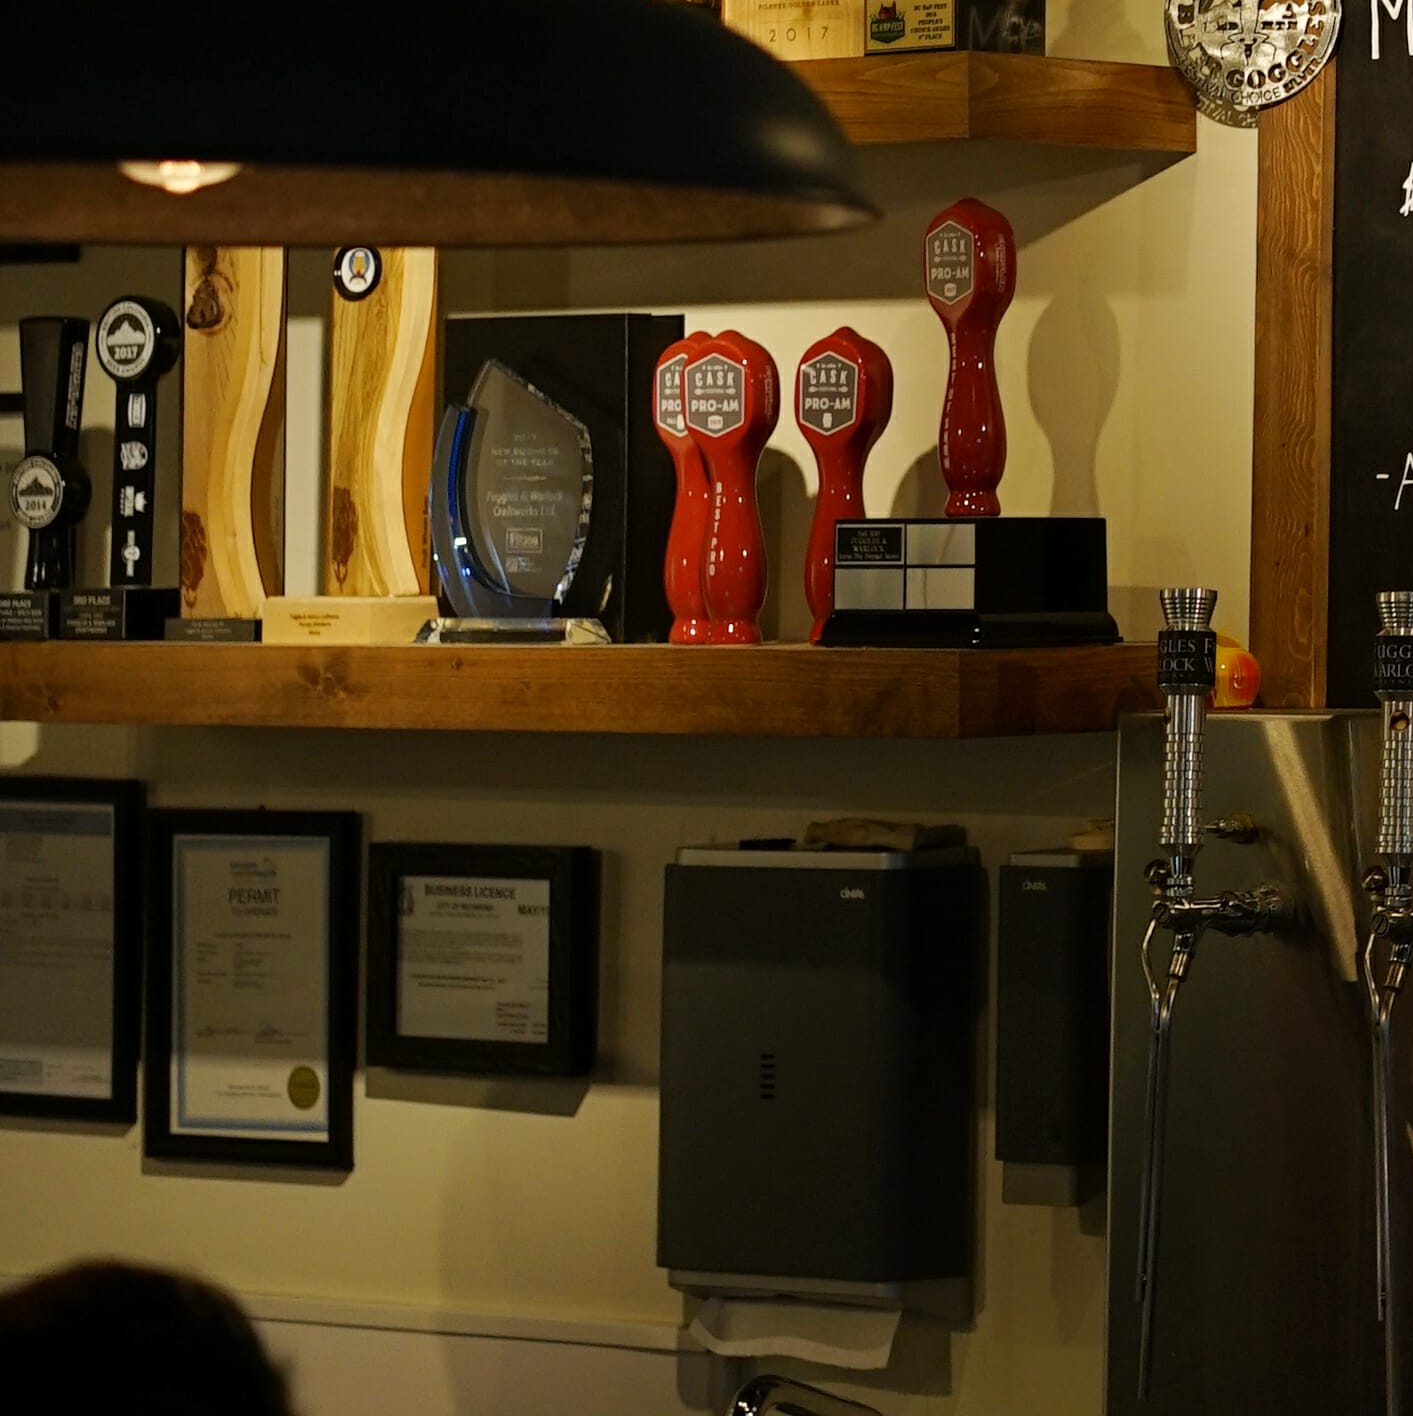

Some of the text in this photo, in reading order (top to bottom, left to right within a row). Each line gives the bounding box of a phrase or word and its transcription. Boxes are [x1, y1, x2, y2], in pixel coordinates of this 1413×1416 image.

[934, 239, 966, 253] CASK
[931, 266, 969, 280] PRO-AM
[695, 373, 735, 386] CASK
[809, 371, 848, 385] CASK
[691, 399, 739, 413] PRO-AM
[805, 397, 851, 411] PRO-AM
[228, 887, 281, 905] PERMIT
